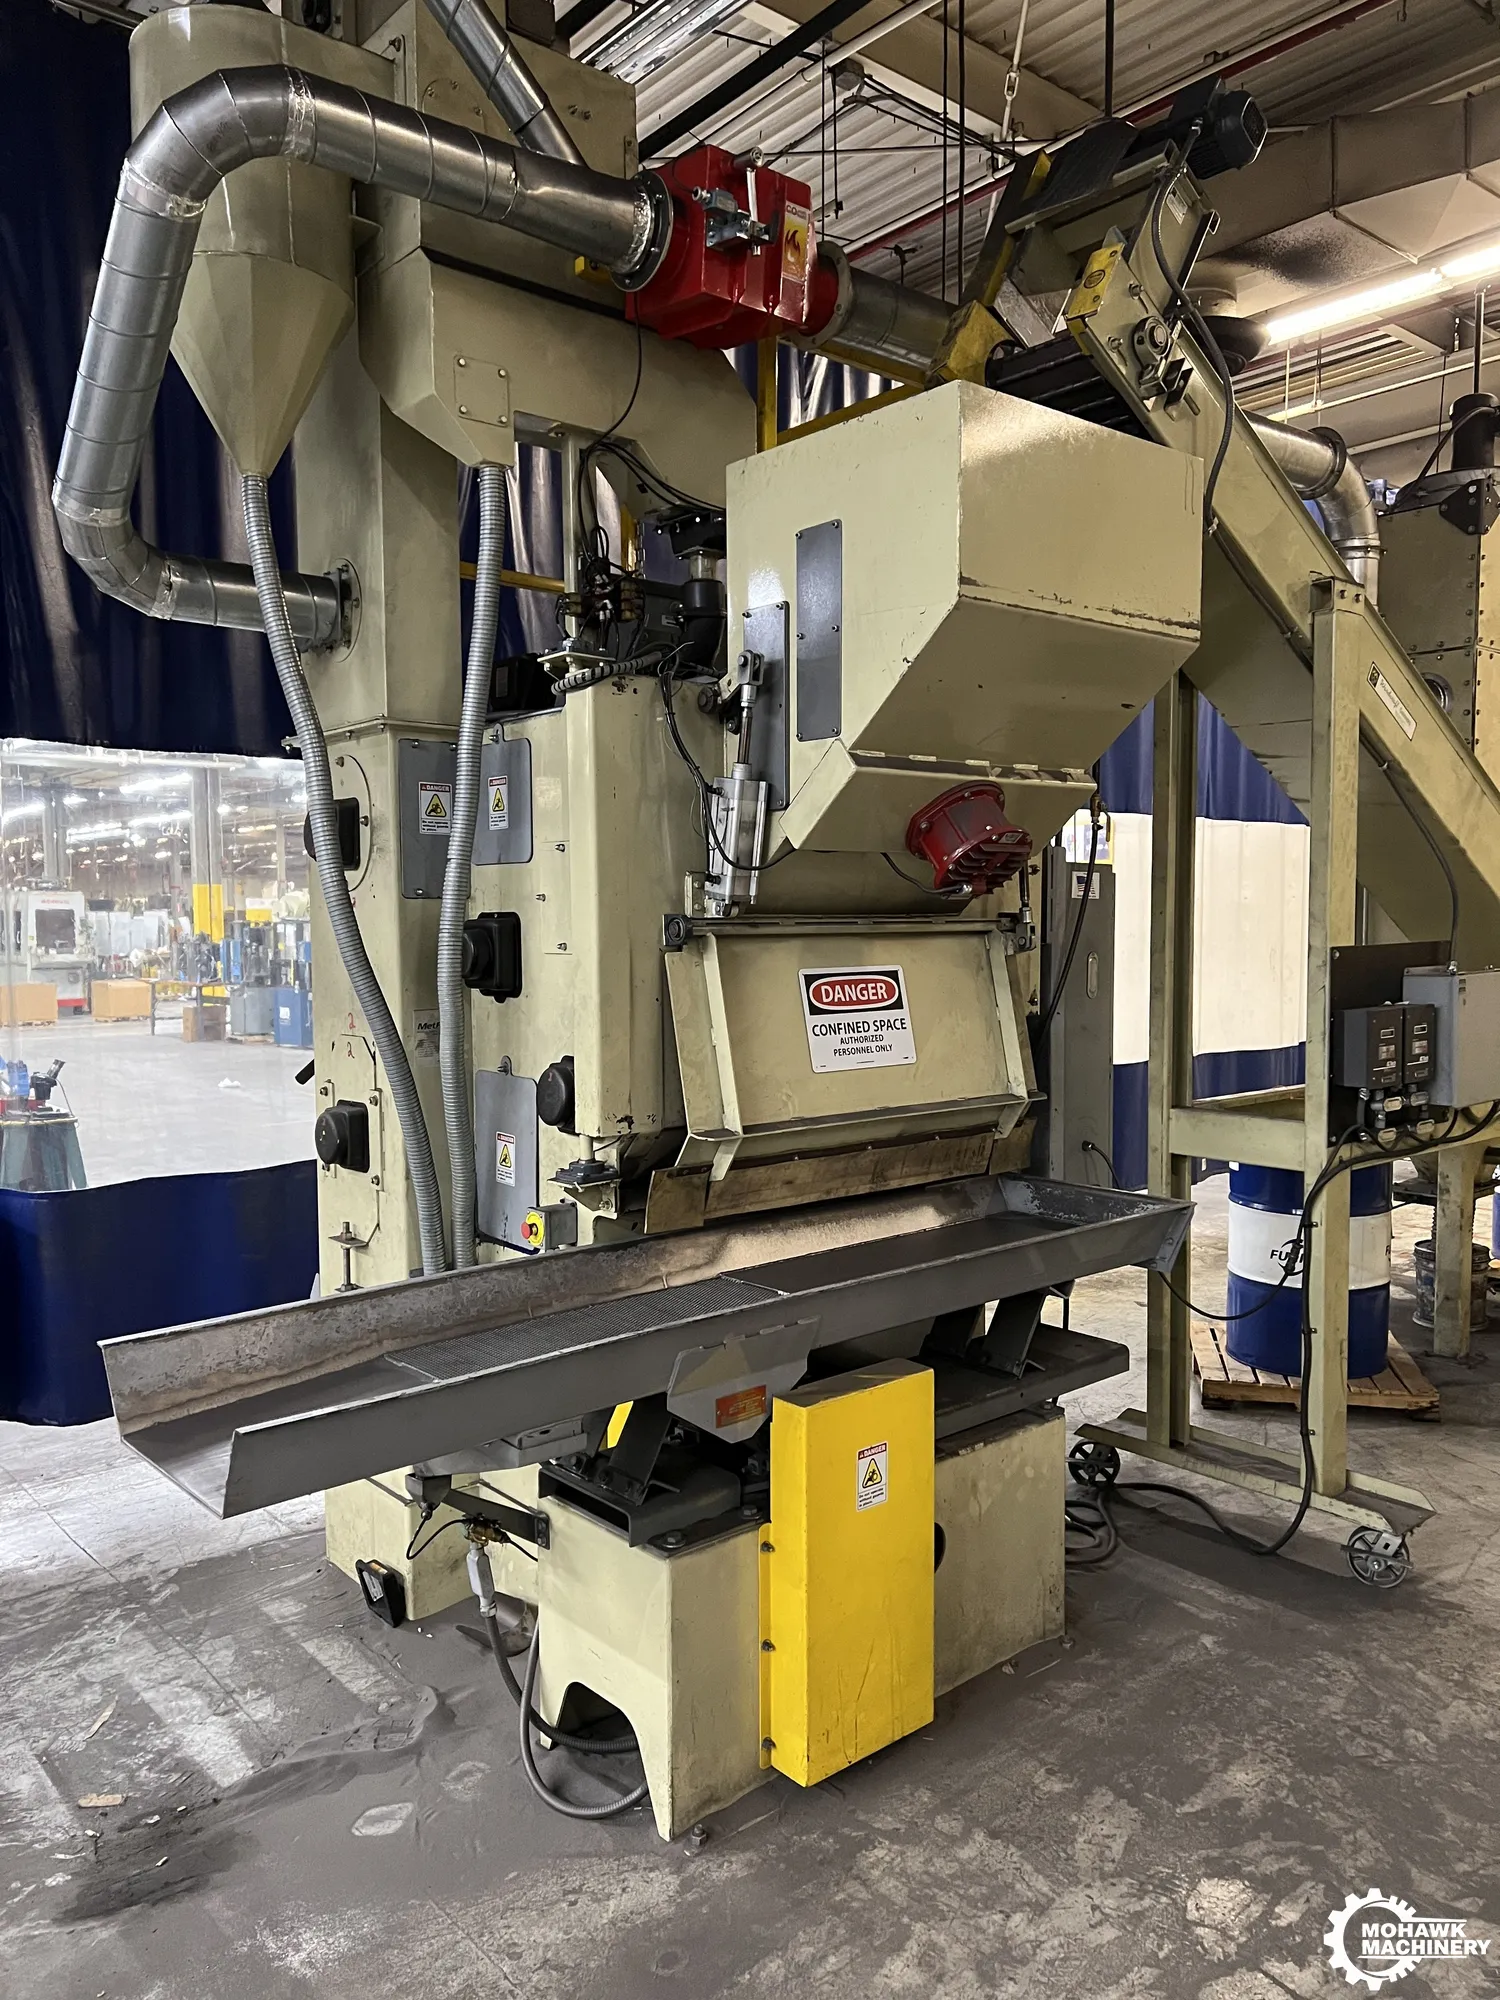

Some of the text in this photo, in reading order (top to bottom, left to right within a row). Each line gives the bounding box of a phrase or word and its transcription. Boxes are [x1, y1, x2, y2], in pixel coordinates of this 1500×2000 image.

[821, 983, 887, 1002] DANGER
[812, 1017, 907, 1036] CONFINED SPACE
[840, 1034, 884, 1045] AUTHORIZED
[833, 1044, 893, 1056] PERSONNEL ONLY
[863, 1445, 886, 1456] DANGER
